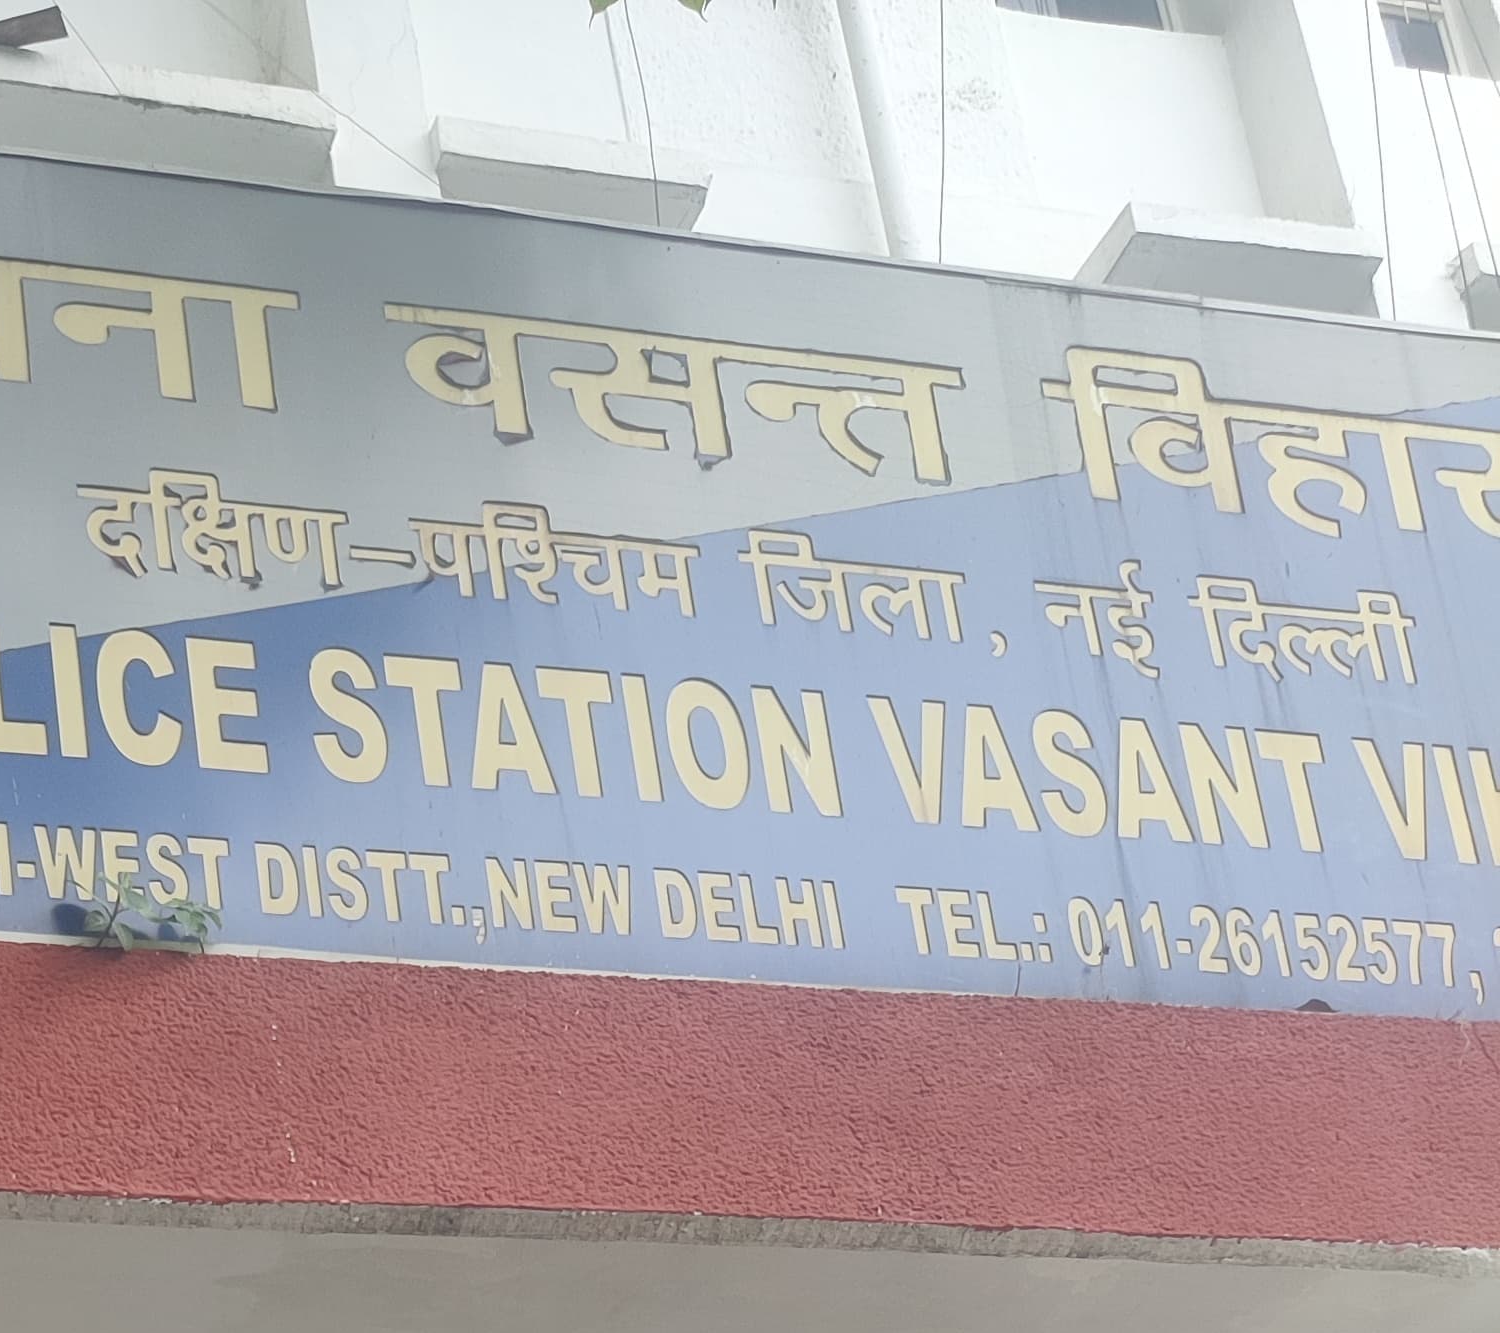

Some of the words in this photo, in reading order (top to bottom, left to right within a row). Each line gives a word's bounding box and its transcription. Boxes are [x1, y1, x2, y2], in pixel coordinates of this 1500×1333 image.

[383, 301, 967, 488] वसन्त
[1033, 558, 1161, 681] नई
[1186, 574, 1418, 686] दिल्ली
[307, 646, 844, 819] STATION
[865, 694, 1326, 854] VASANT
[652, 866, 846, 950] DELHI
[894, 885, 1053, 964] TEL.:
